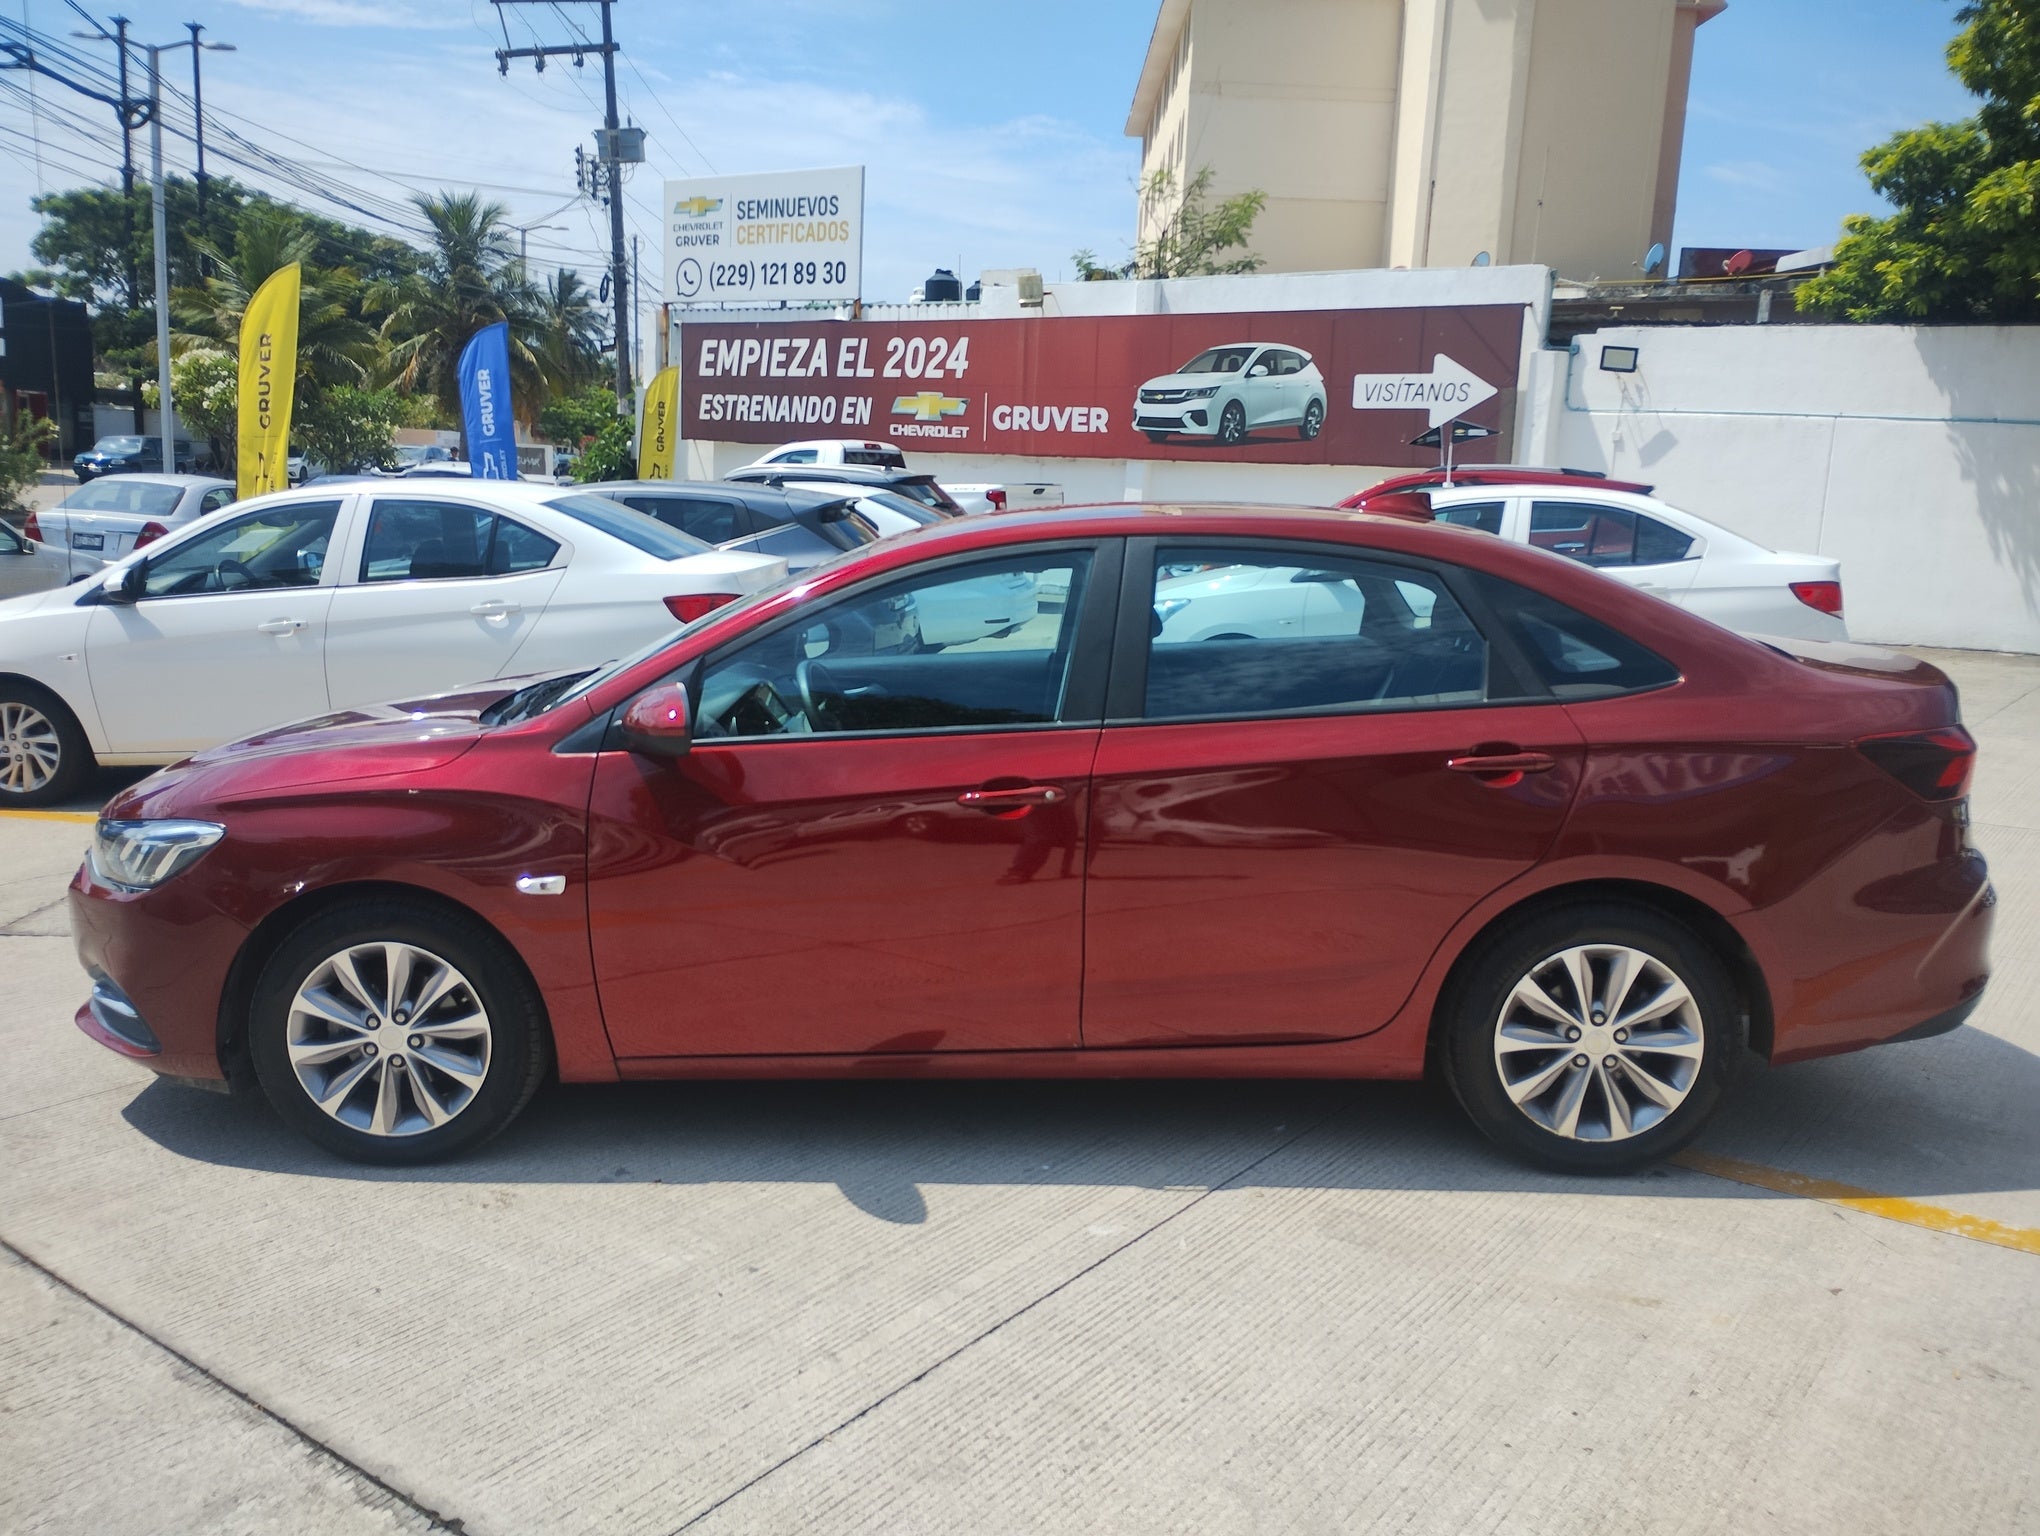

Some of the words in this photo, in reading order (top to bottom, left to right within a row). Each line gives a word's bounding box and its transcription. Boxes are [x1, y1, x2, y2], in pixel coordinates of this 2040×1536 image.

[737, 195, 839, 220] SEMINUEVOS
[673, 221, 724, 233] CHEVROLET
[675, 234, 720, 247] GRUVER
[737, 220, 849, 245] CERTIFICADOS
[709, 260, 755, 291] (229)
[760, 262, 788, 285] 121
[793, 261, 816, 284] 89
[822, 261, 847, 284] 30
[698, 337, 828, 378] EMPIEZA
[836, 337, 876, 378] EL
[882, 336, 969, 379] 2024
[258, 333, 273, 430] GRUVER
[1365, 376, 1470, 402] VISÍTANOS
[477, 368, 496, 437] GRUVER
[698, 393, 835, 424] ESTRENANDO
[840, 396, 872, 425] EN
[656, 401, 666, 452] GRUVER
[889, 423, 970, 439] CHEVROLET
[992, 404, 1109, 433] GRUVER
